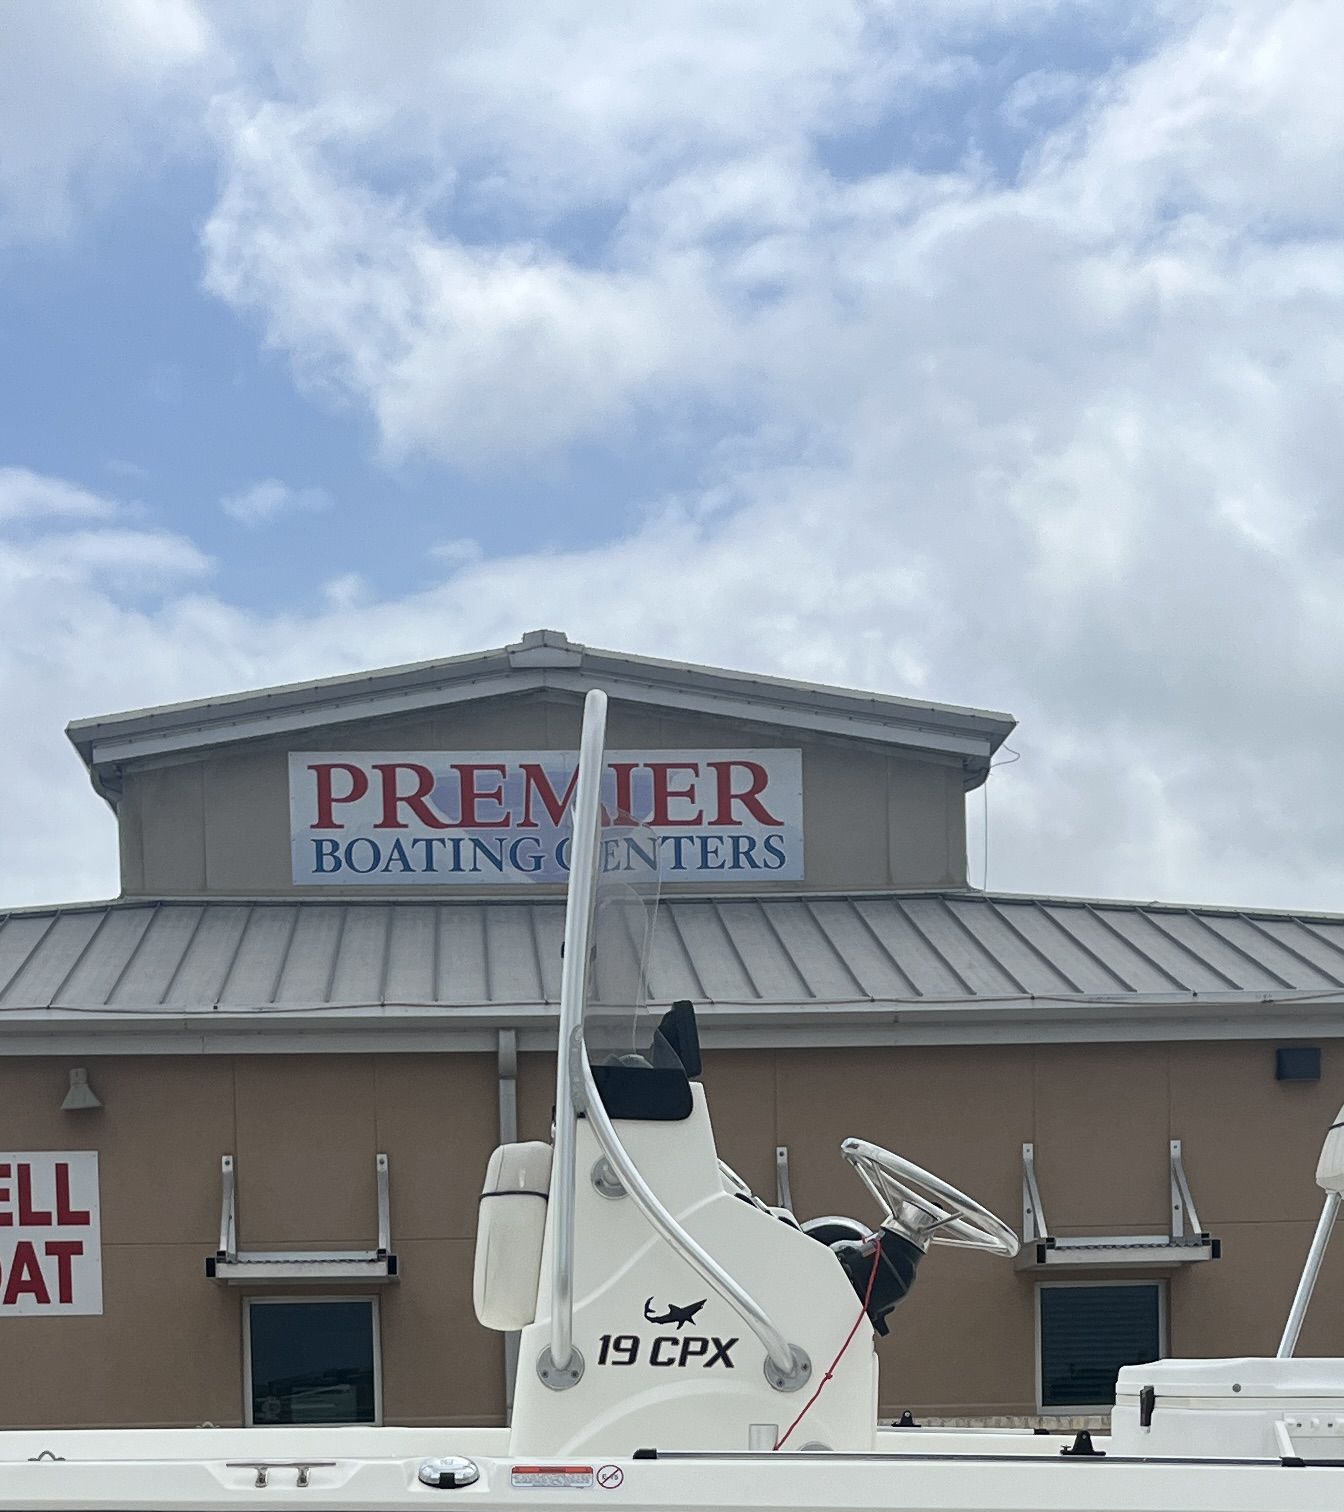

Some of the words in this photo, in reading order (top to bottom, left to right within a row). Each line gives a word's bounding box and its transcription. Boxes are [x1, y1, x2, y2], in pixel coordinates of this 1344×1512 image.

[307, 763, 785, 829] PREMIER
[310, 837, 545, 874] BOATING
[598, 1335, 640, 1365] 19
[649, 1336, 739, 1368] CPX
